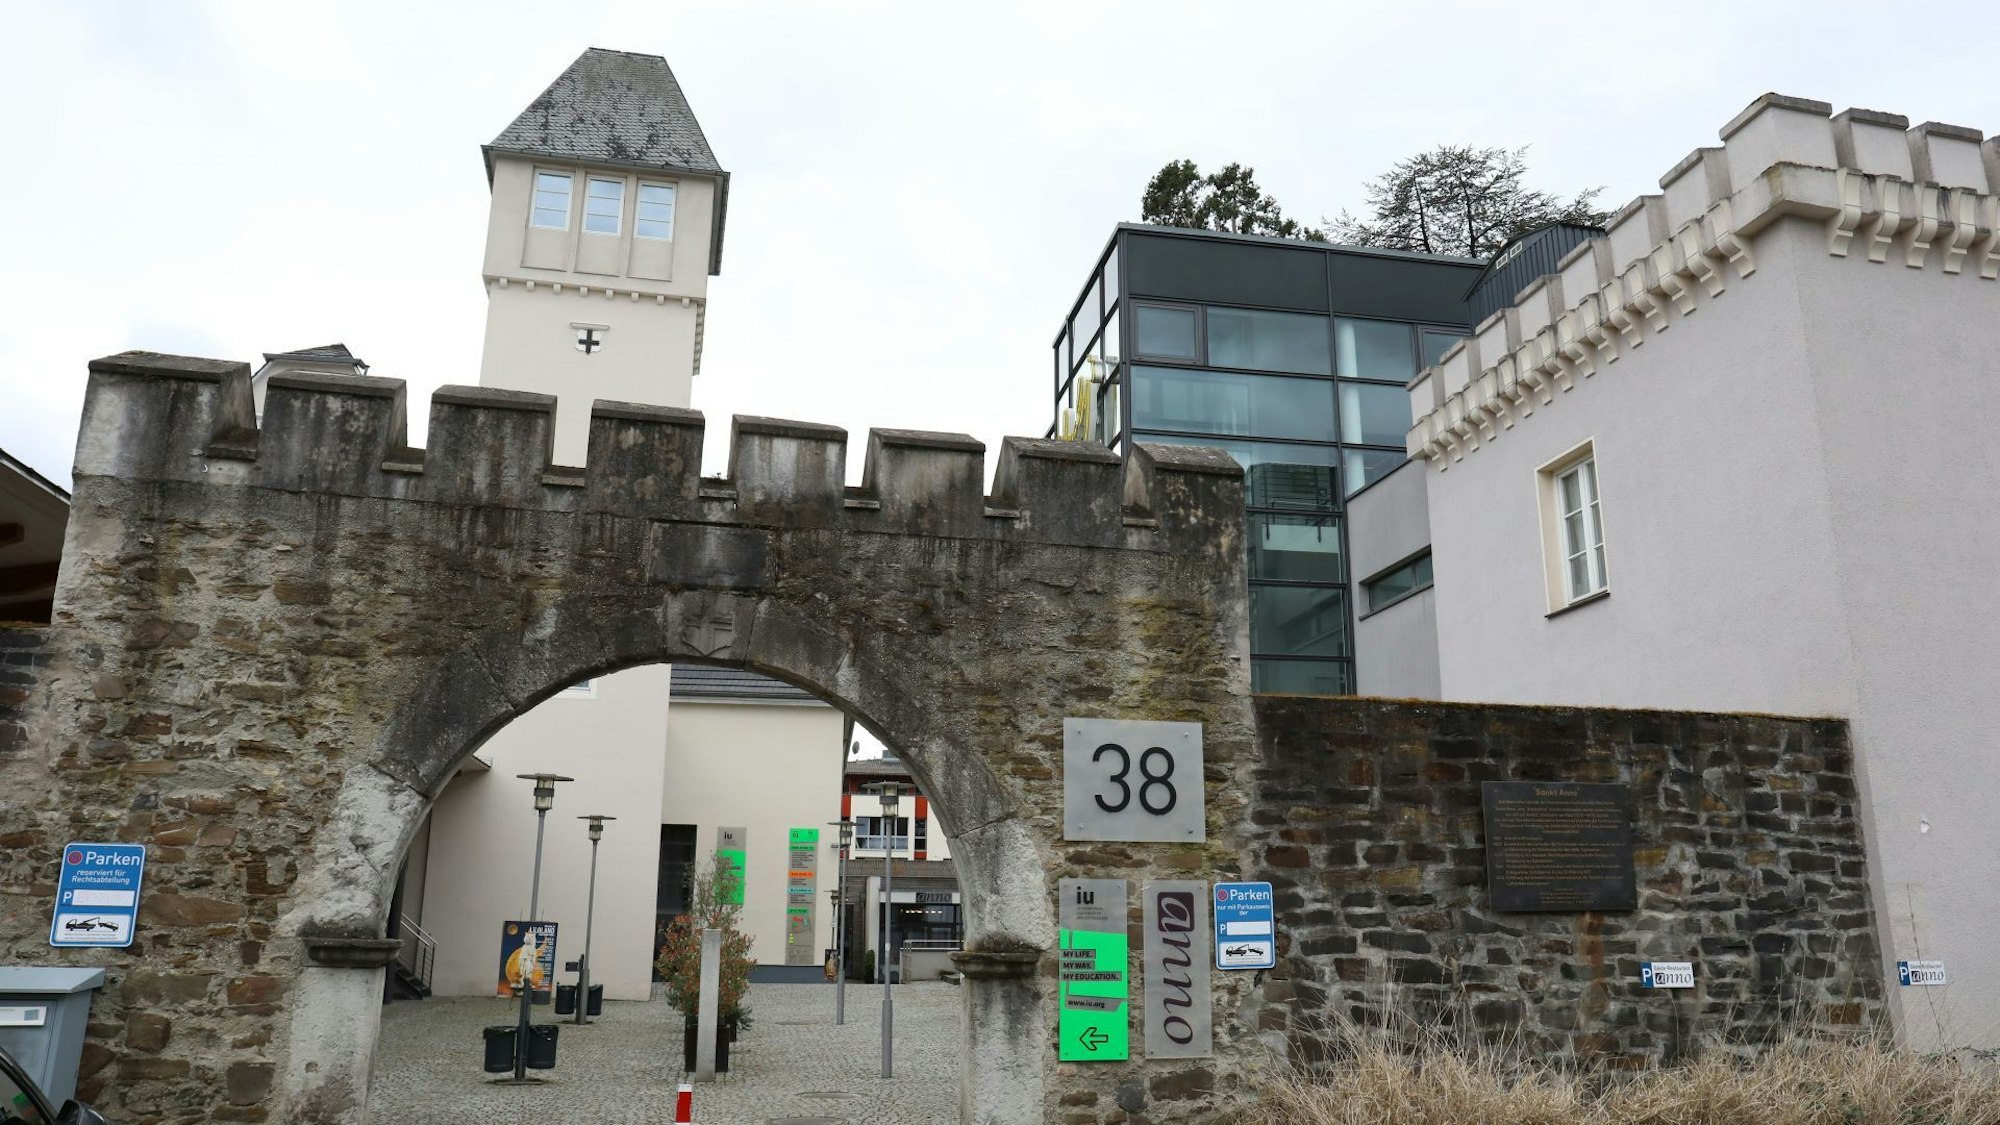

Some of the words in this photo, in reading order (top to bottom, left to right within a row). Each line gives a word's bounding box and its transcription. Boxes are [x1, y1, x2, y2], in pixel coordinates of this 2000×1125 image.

[1092, 743, 1177, 816] 38
[85, 851, 141, 866] Parken
[72, 875, 130, 885] Rechtsabteilung
[62, 891, 72, 904] P
[917, 892, 951, 902] anno
[1077, 886, 1094, 905] iu
[1229, 889, 1270, 901] Parken
[1220, 924, 1226, 934] P
[1160, 896, 1194, 1045] anno
[1642, 968, 1652, 983] P
[1899, 966, 1908, 981] P
[1911, 970, 1944, 982] anno
[1656, 973, 1692, 984] anno
[1068, 1000, 1105, 1009] www.iu.org
